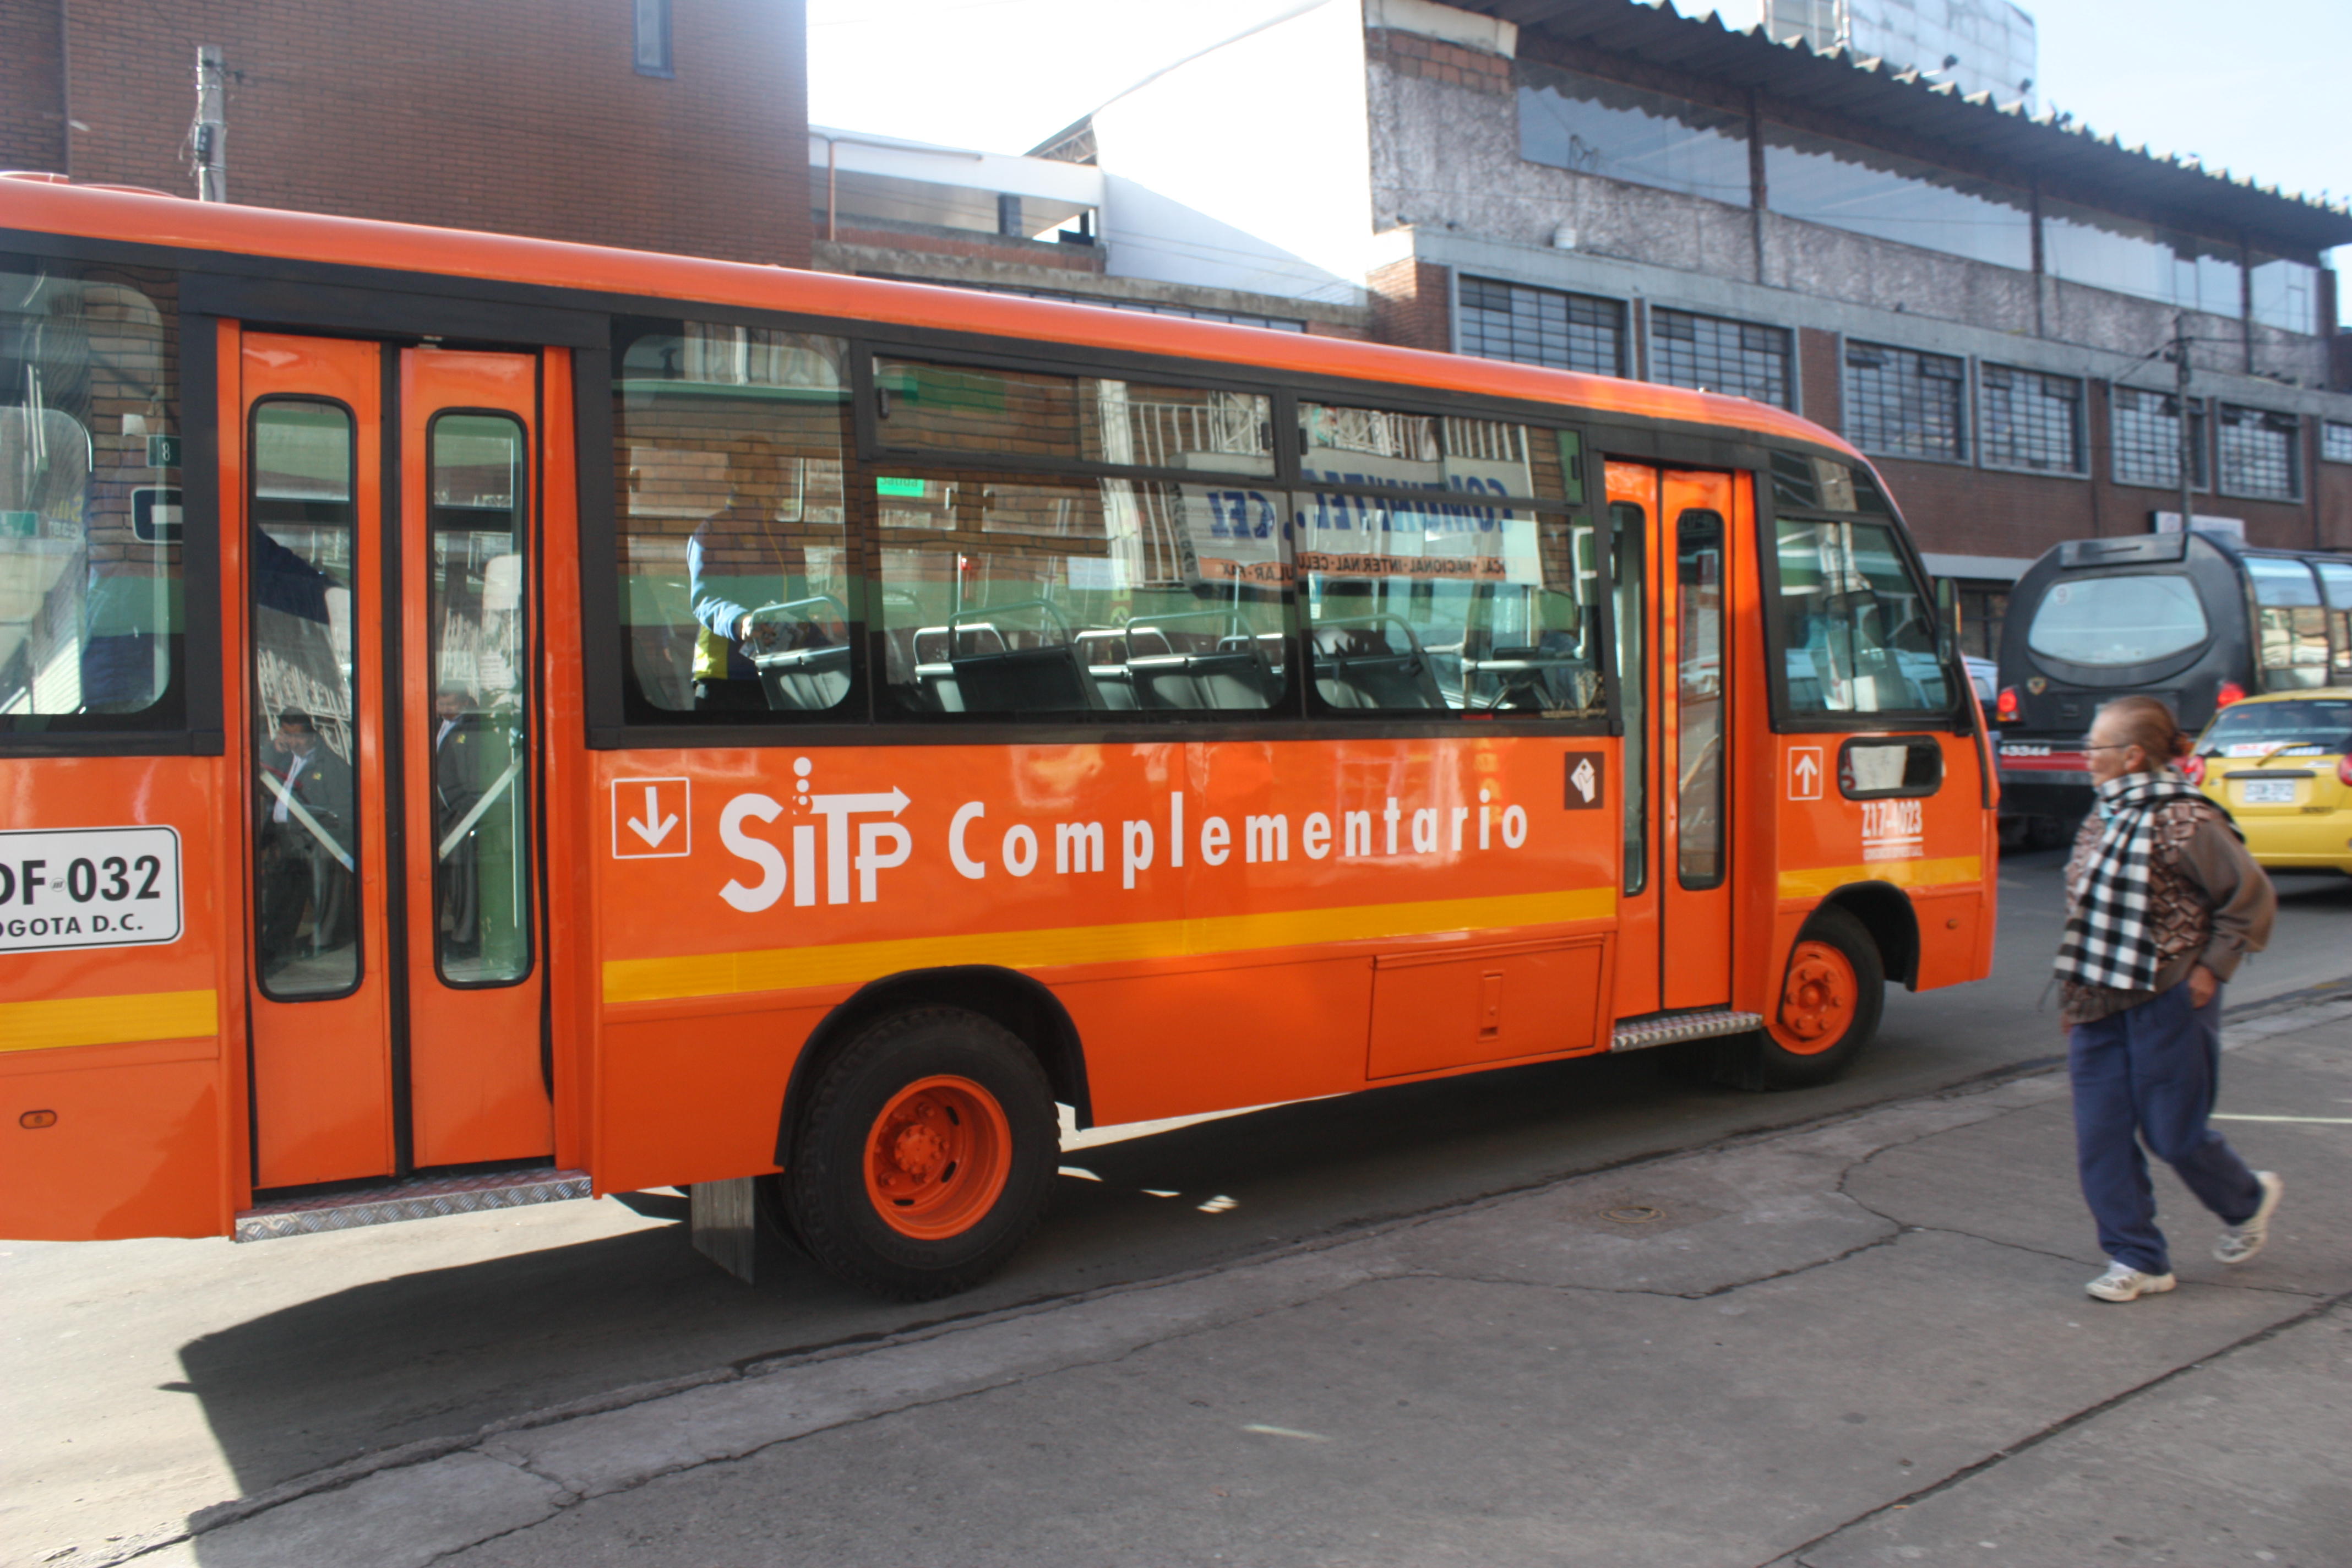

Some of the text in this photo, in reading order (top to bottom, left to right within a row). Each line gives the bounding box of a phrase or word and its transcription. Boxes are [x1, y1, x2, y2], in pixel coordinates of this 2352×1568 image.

[948, 789, 1528, 890] Complementario
[67, 854, 161, 903] 032
[0, 913, 144, 938] GOTA D.C.
